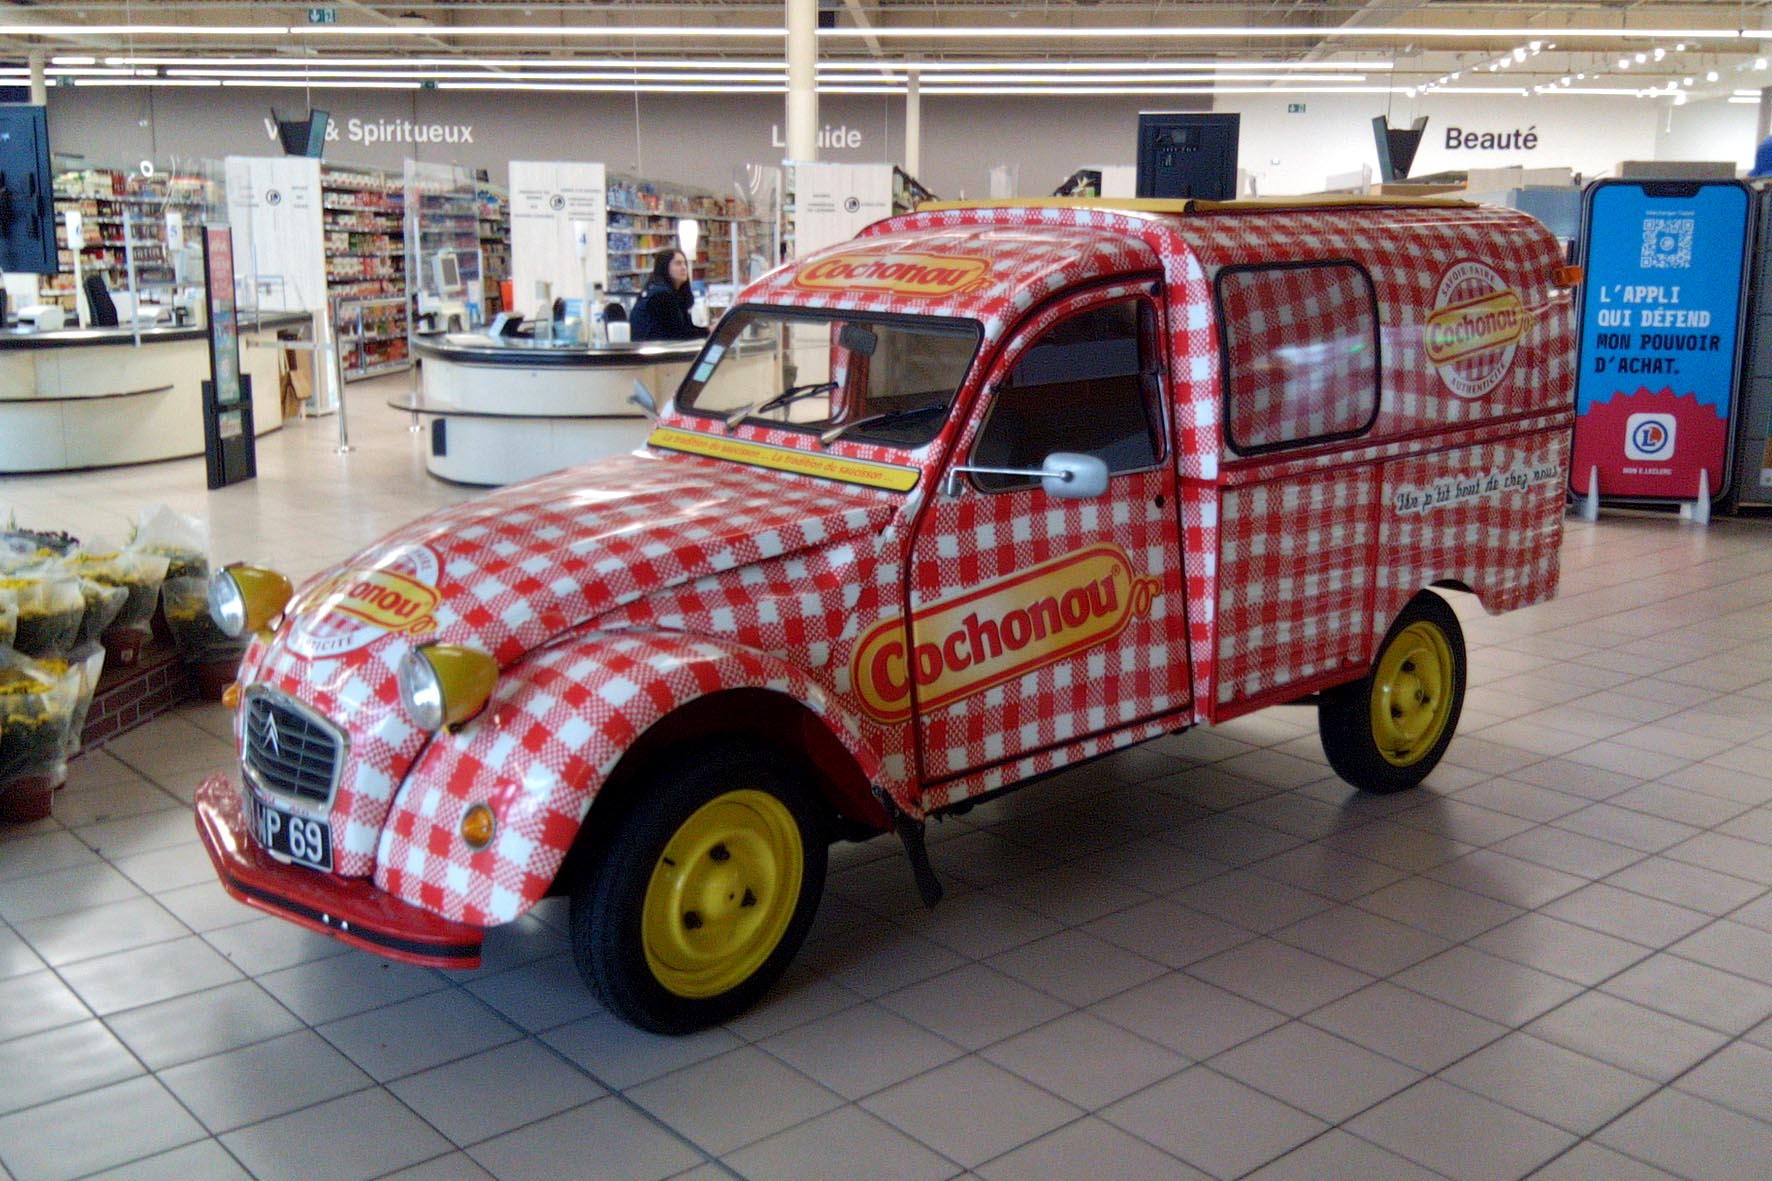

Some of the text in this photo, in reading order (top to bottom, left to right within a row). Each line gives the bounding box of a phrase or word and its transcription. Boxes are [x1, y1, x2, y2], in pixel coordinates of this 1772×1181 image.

[348, 117, 474, 146] Spiritueux
[1445, 125, 1538, 150] Beauté
[804, 257, 971, 287] Cochonou
[1600, 285, 1681, 304] L'APPLI
[1597, 307, 1711, 328] QUI DÉFEND
[1430, 307, 1517, 354] Cochonou
[1596, 333, 1720, 351] MON POUVOIR
[1594, 357, 1680, 375] D'ACHAT.
[1533, 465, 1558, 482] nous
[870, 573, 1121, 702] Cochonou
[289, 817, 322, 863] 69
